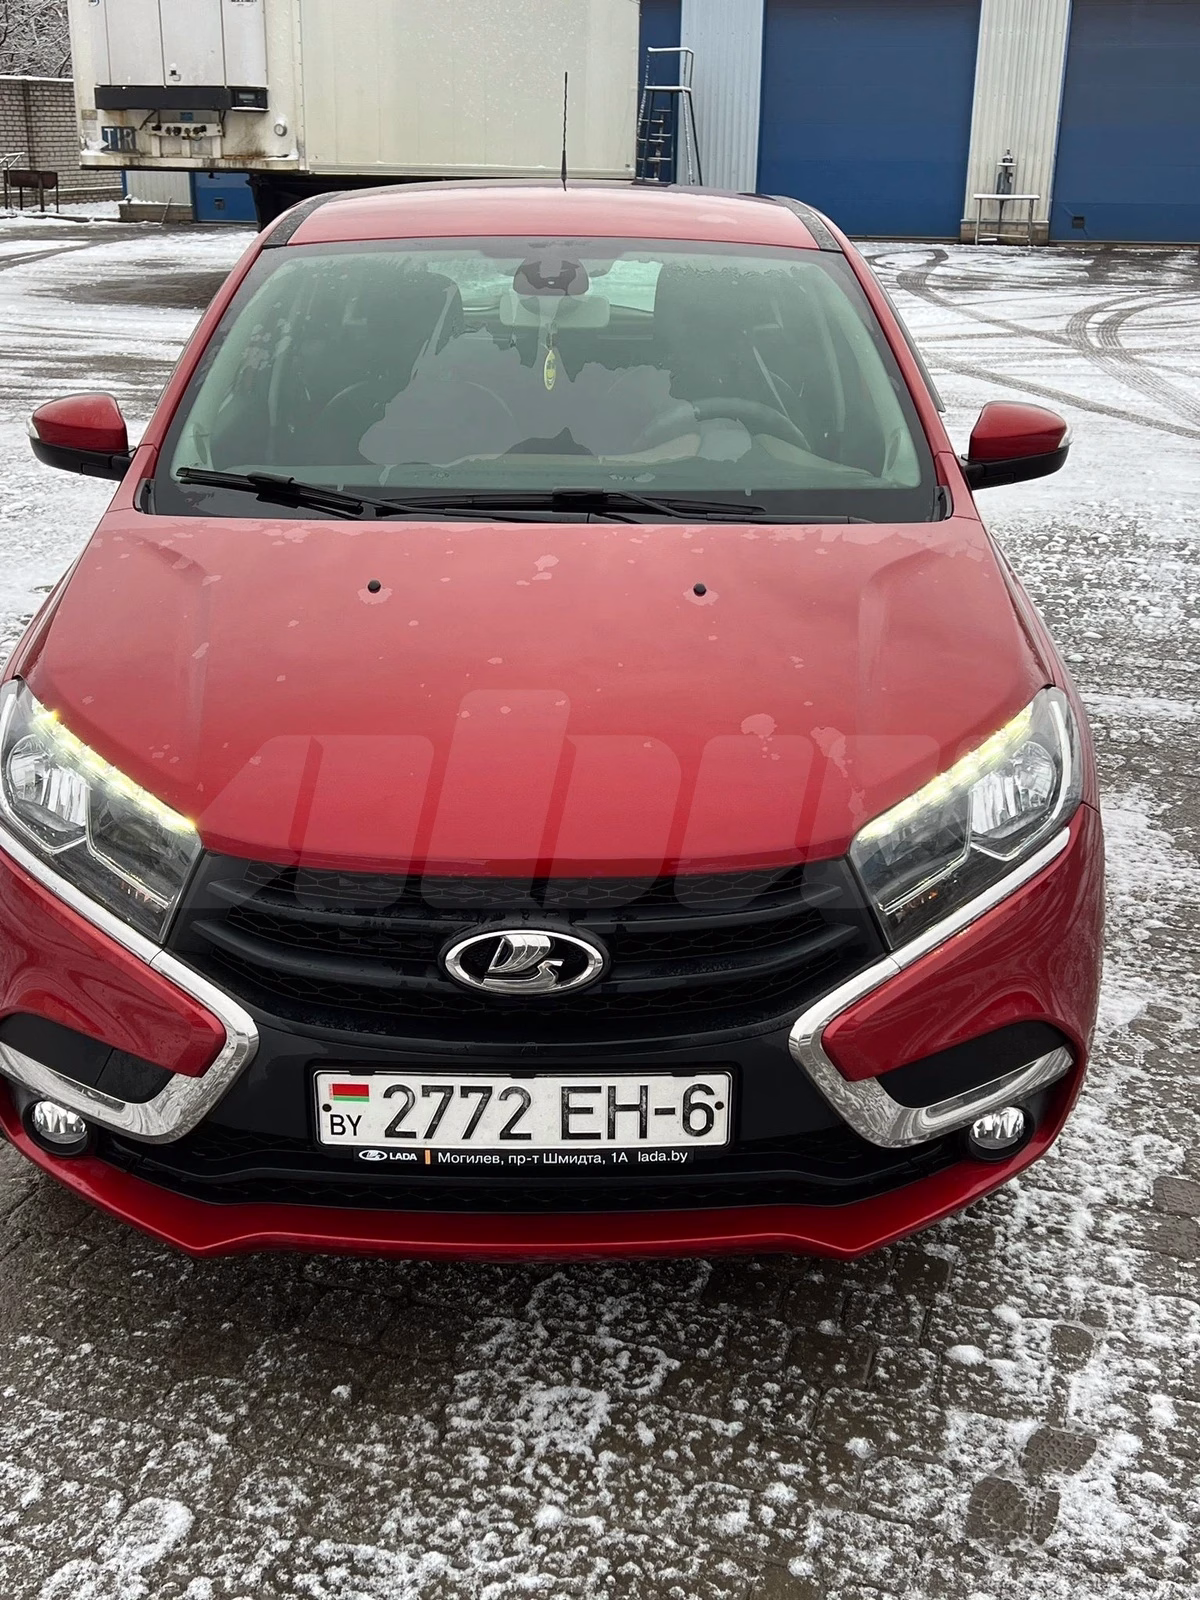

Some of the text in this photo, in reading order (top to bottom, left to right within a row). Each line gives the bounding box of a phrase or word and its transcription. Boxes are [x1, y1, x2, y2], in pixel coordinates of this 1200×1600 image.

[104, 128, 133, 149] TIR
[383, 1083, 716, 1140] 2772 EH-6
[329, 1114, 362, 1137] BY
[389, 1152, 418, 1161] LADA
[437, 1152, 504, 1166] Могилев,
[508, 1154, 540, 1166] пр-т
[543, 1152, 606, 1165] Шмидта,
[637, 1150, 688, 1163] lada.by
